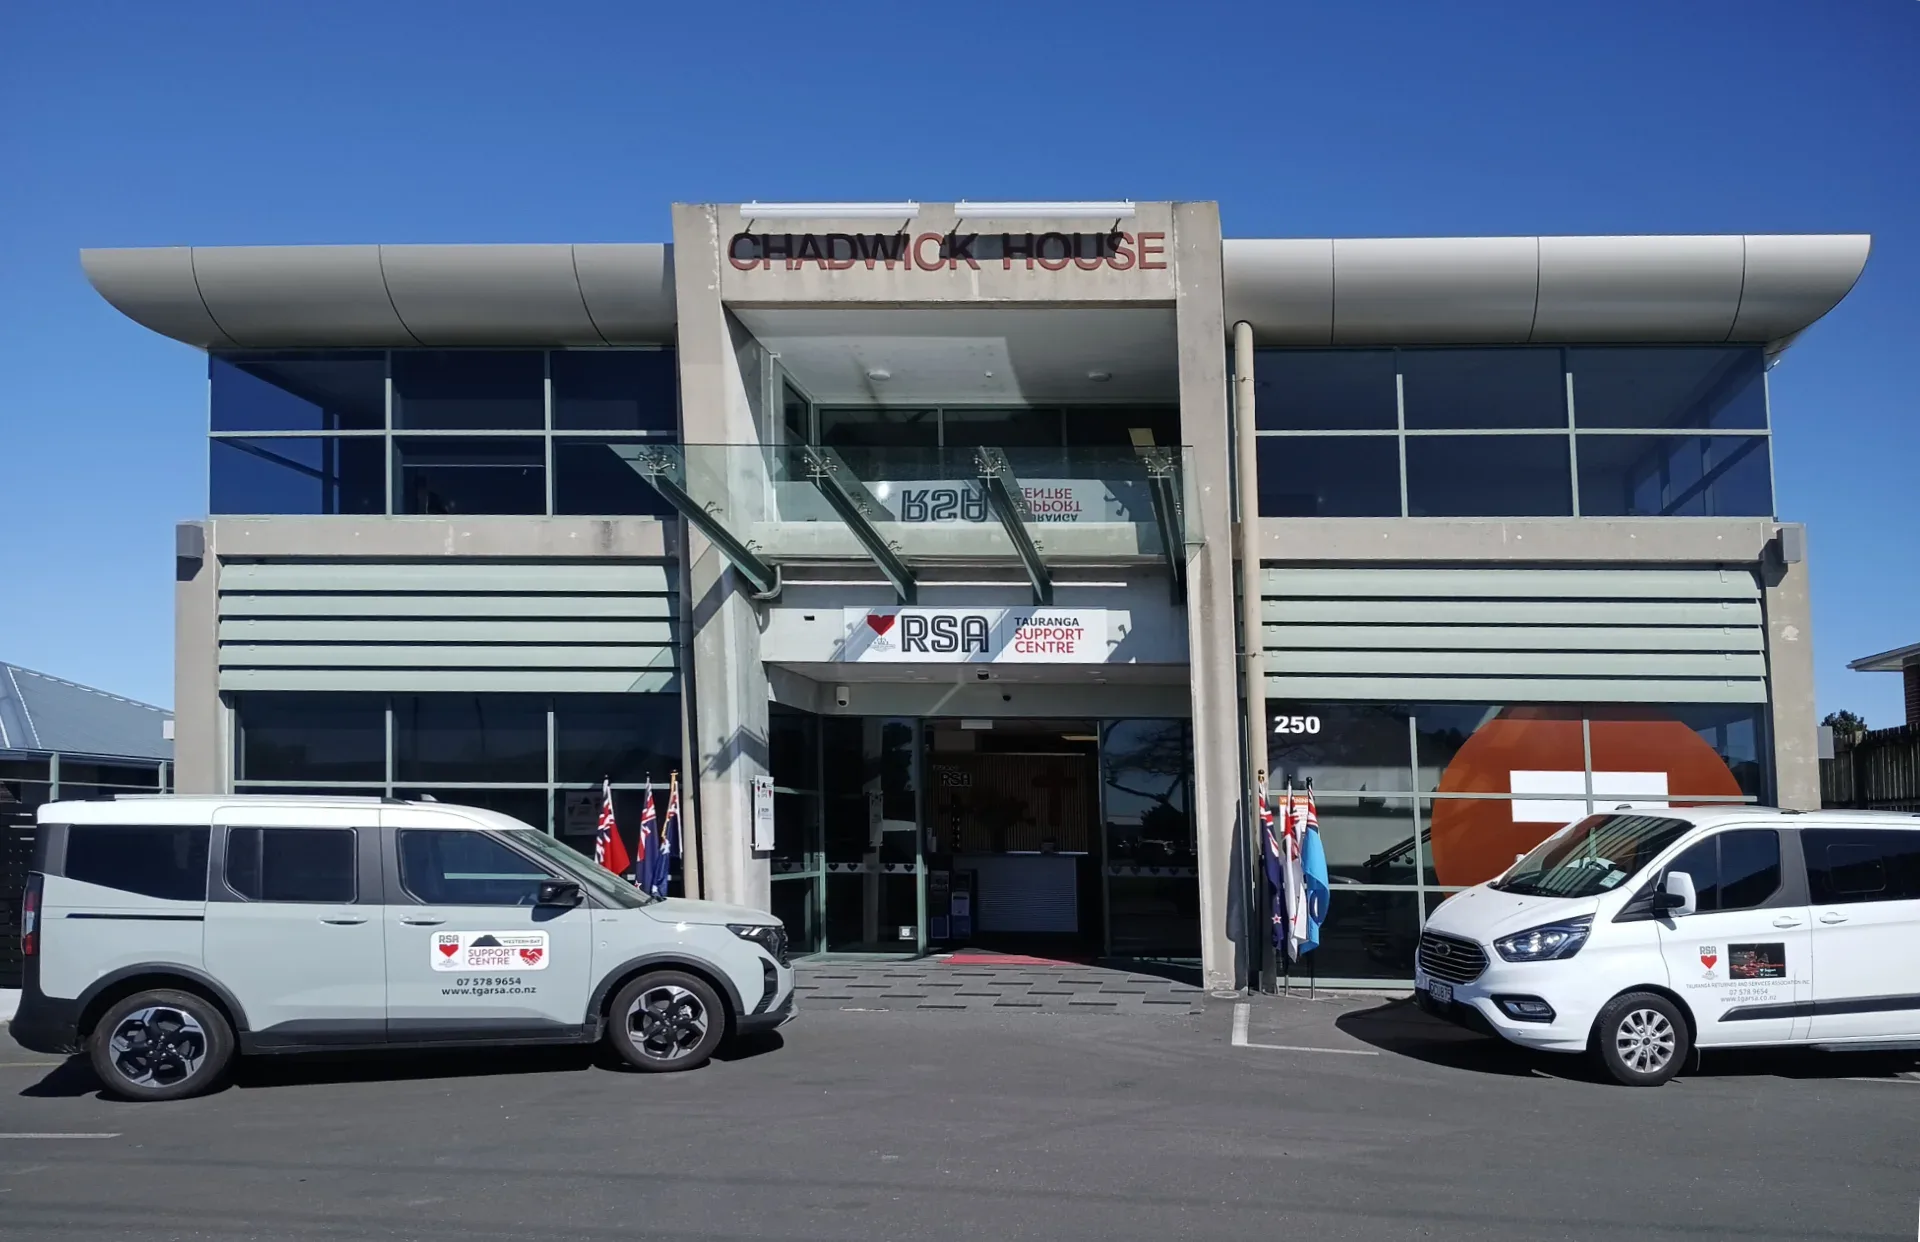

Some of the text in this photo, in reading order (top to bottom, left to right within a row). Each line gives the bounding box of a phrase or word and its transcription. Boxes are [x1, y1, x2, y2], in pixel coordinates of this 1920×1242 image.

[727, 231, 1168, 272] CHADWICK HOUSE
[1014, 617, 1080, 627] TAURANGA
[901, 615, 990, 653] RSA
[1015, 628, 1084, 641] SUPPORT
[1015, 641, 1075, 654] CENTRE
[1274, 715, 1321, 734] 250
[438, 935, 459, 943] RSA
[468, 948, 516, 957] SUPPORT
[1700, 946, 1717, 954] RSA
[468, 957, 510, 966] CENTRE
[456, 977, 522, 986] 07 578 9654
[441, 986, 537, 997] www.tgarsa.co.nz
[1720, 995, 1777, 1003] www.tgarsa.co.nz
